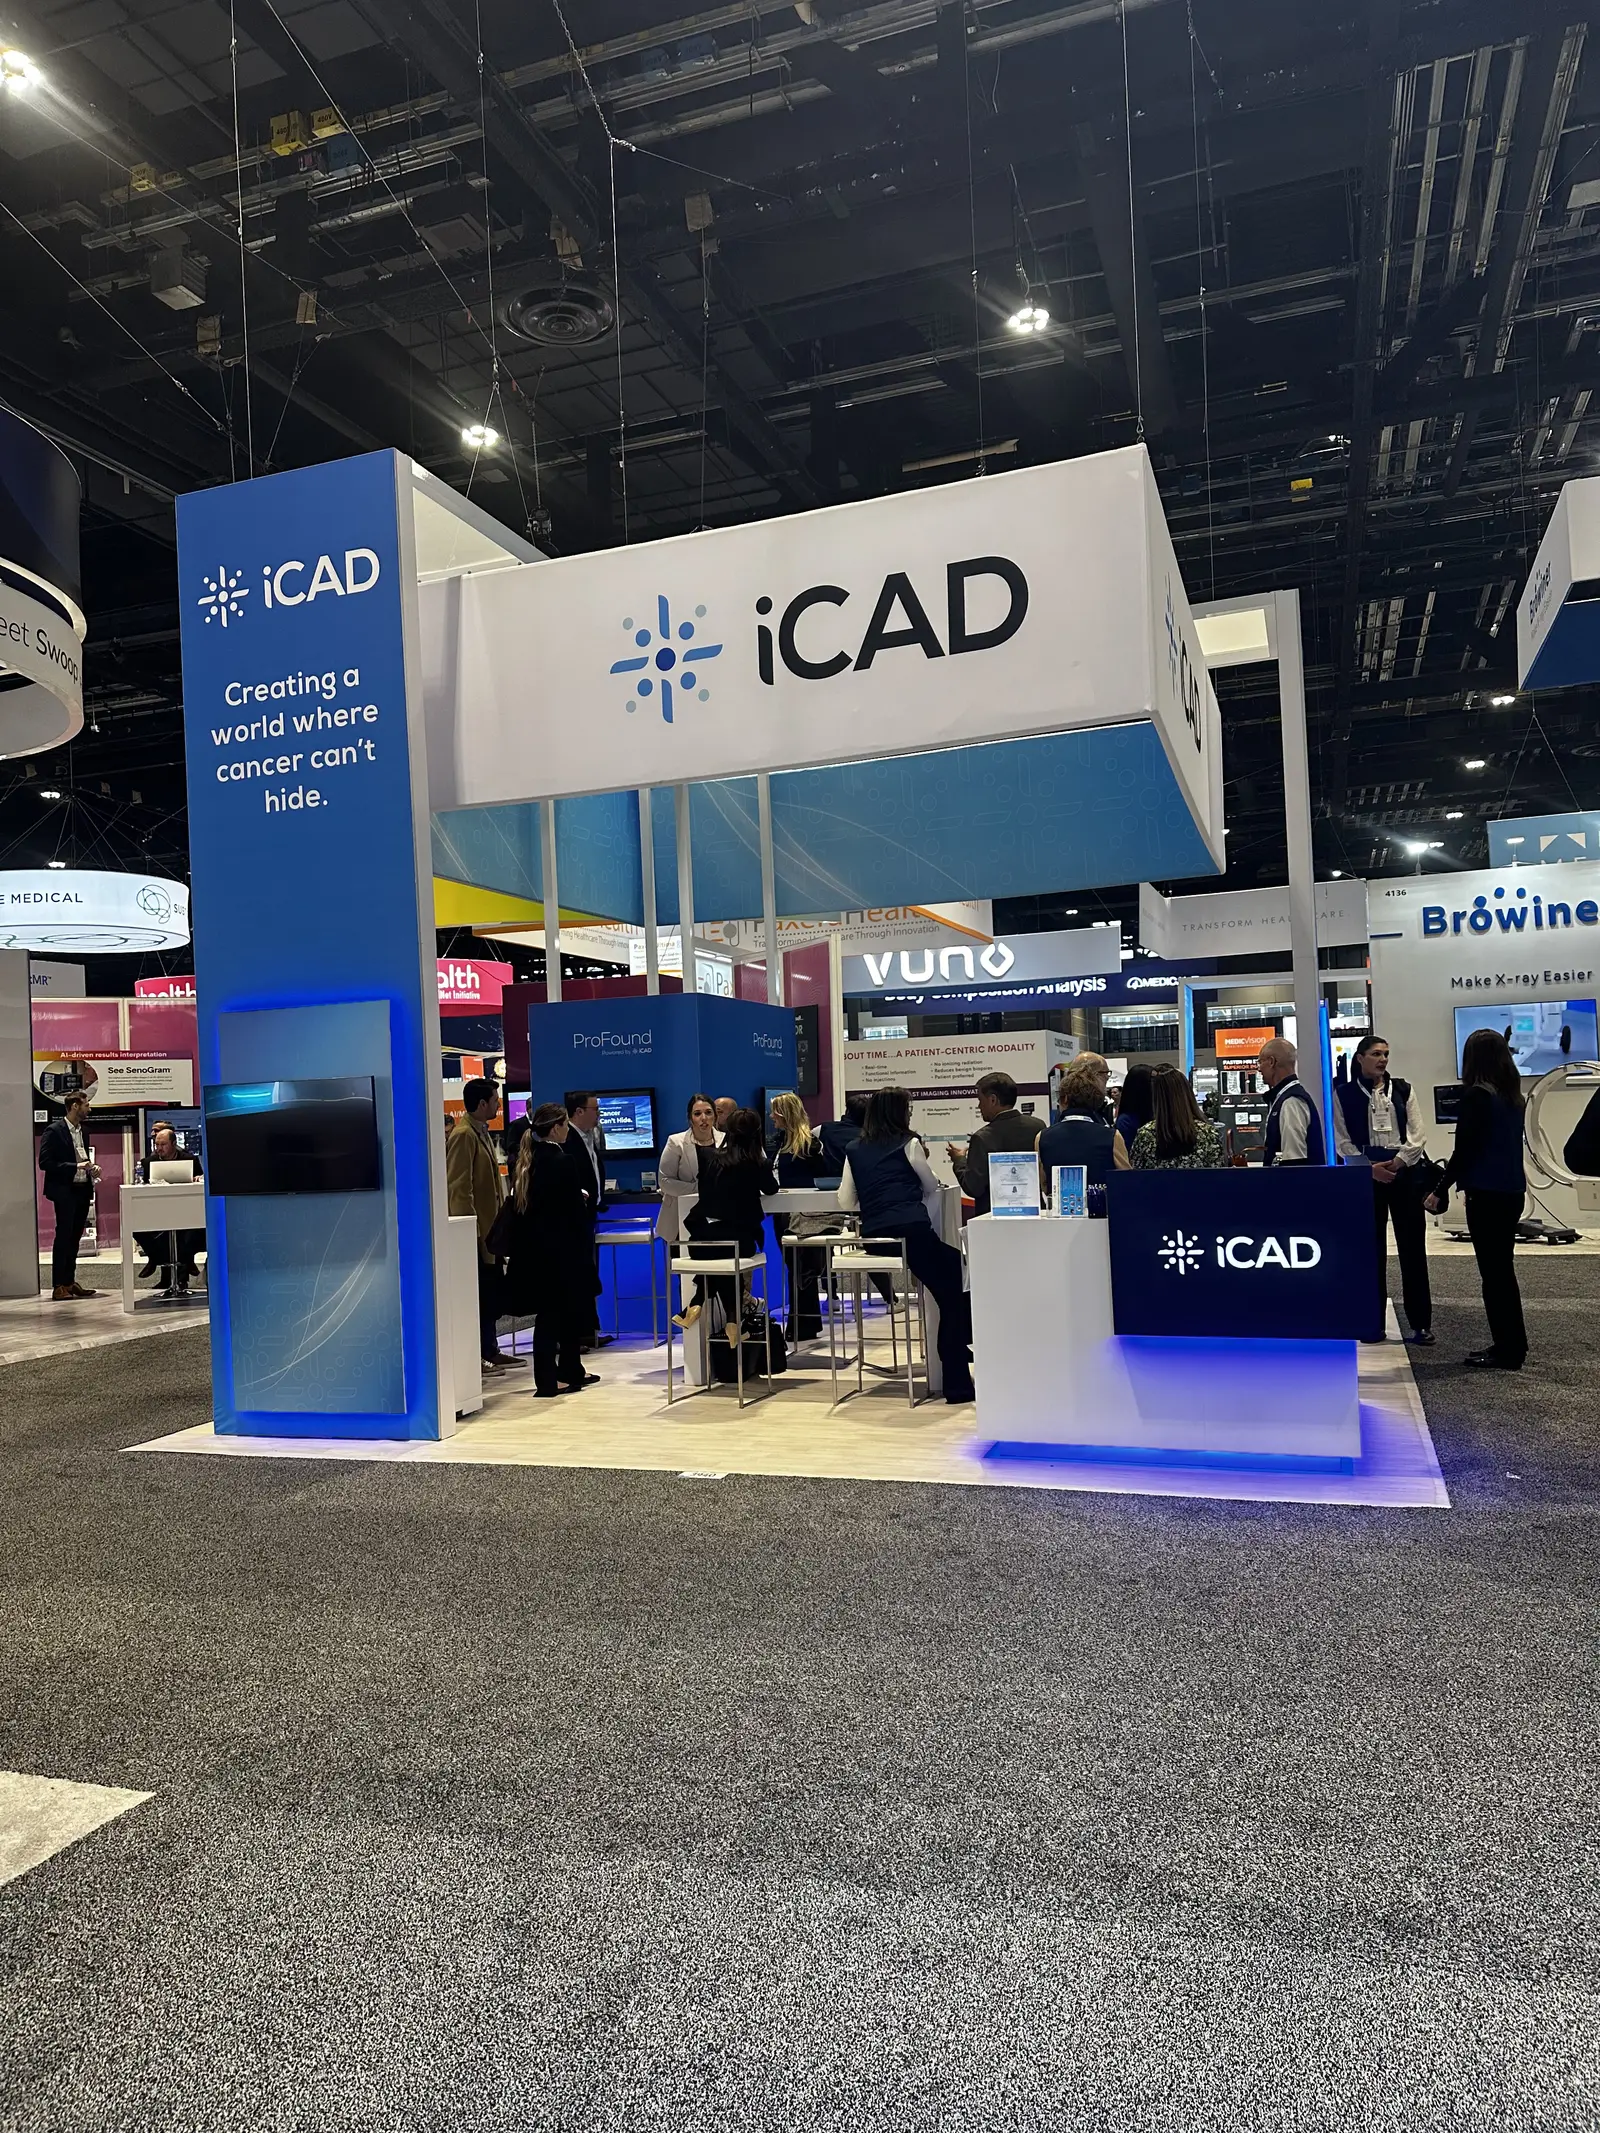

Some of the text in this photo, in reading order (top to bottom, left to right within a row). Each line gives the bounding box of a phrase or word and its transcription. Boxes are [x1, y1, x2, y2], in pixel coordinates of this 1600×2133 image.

[263, 548, 380, 609] iCAD
[755, 556, 1029, 686] iCAD
[36, 628, 79, 685] Swoop
[224, 668, 360, 706] Creating a
[211, 703, 379, 746] world where
[216, 738, 376, 782] cancer can't
[265, 785, 328, 813] hide.
[11, 892, 84, 905] MEDICAL
[1385, 889, 1407, 898] 4136
[854, 929, 891, 941] Through
[893, 924, 940, 937] Innovation
[1182, 919, 1253, 932] TRANSFORM
[1451, 969, 1593, 988] Make X-ray Easier
[573, 1029, 652, 1049] ProFound
[753, 1033, 782, 1050] ProFound
[120, 1051, 167, 1059] interpretation
[905, 1045, 986, 1058] PATIENT-CENTRIC
[988, 1043, 1036, 1053] MODALITY
[126, 1066, 171, 1074] SenoGram
[1216, 1236, 1322, 1269] iCAD
